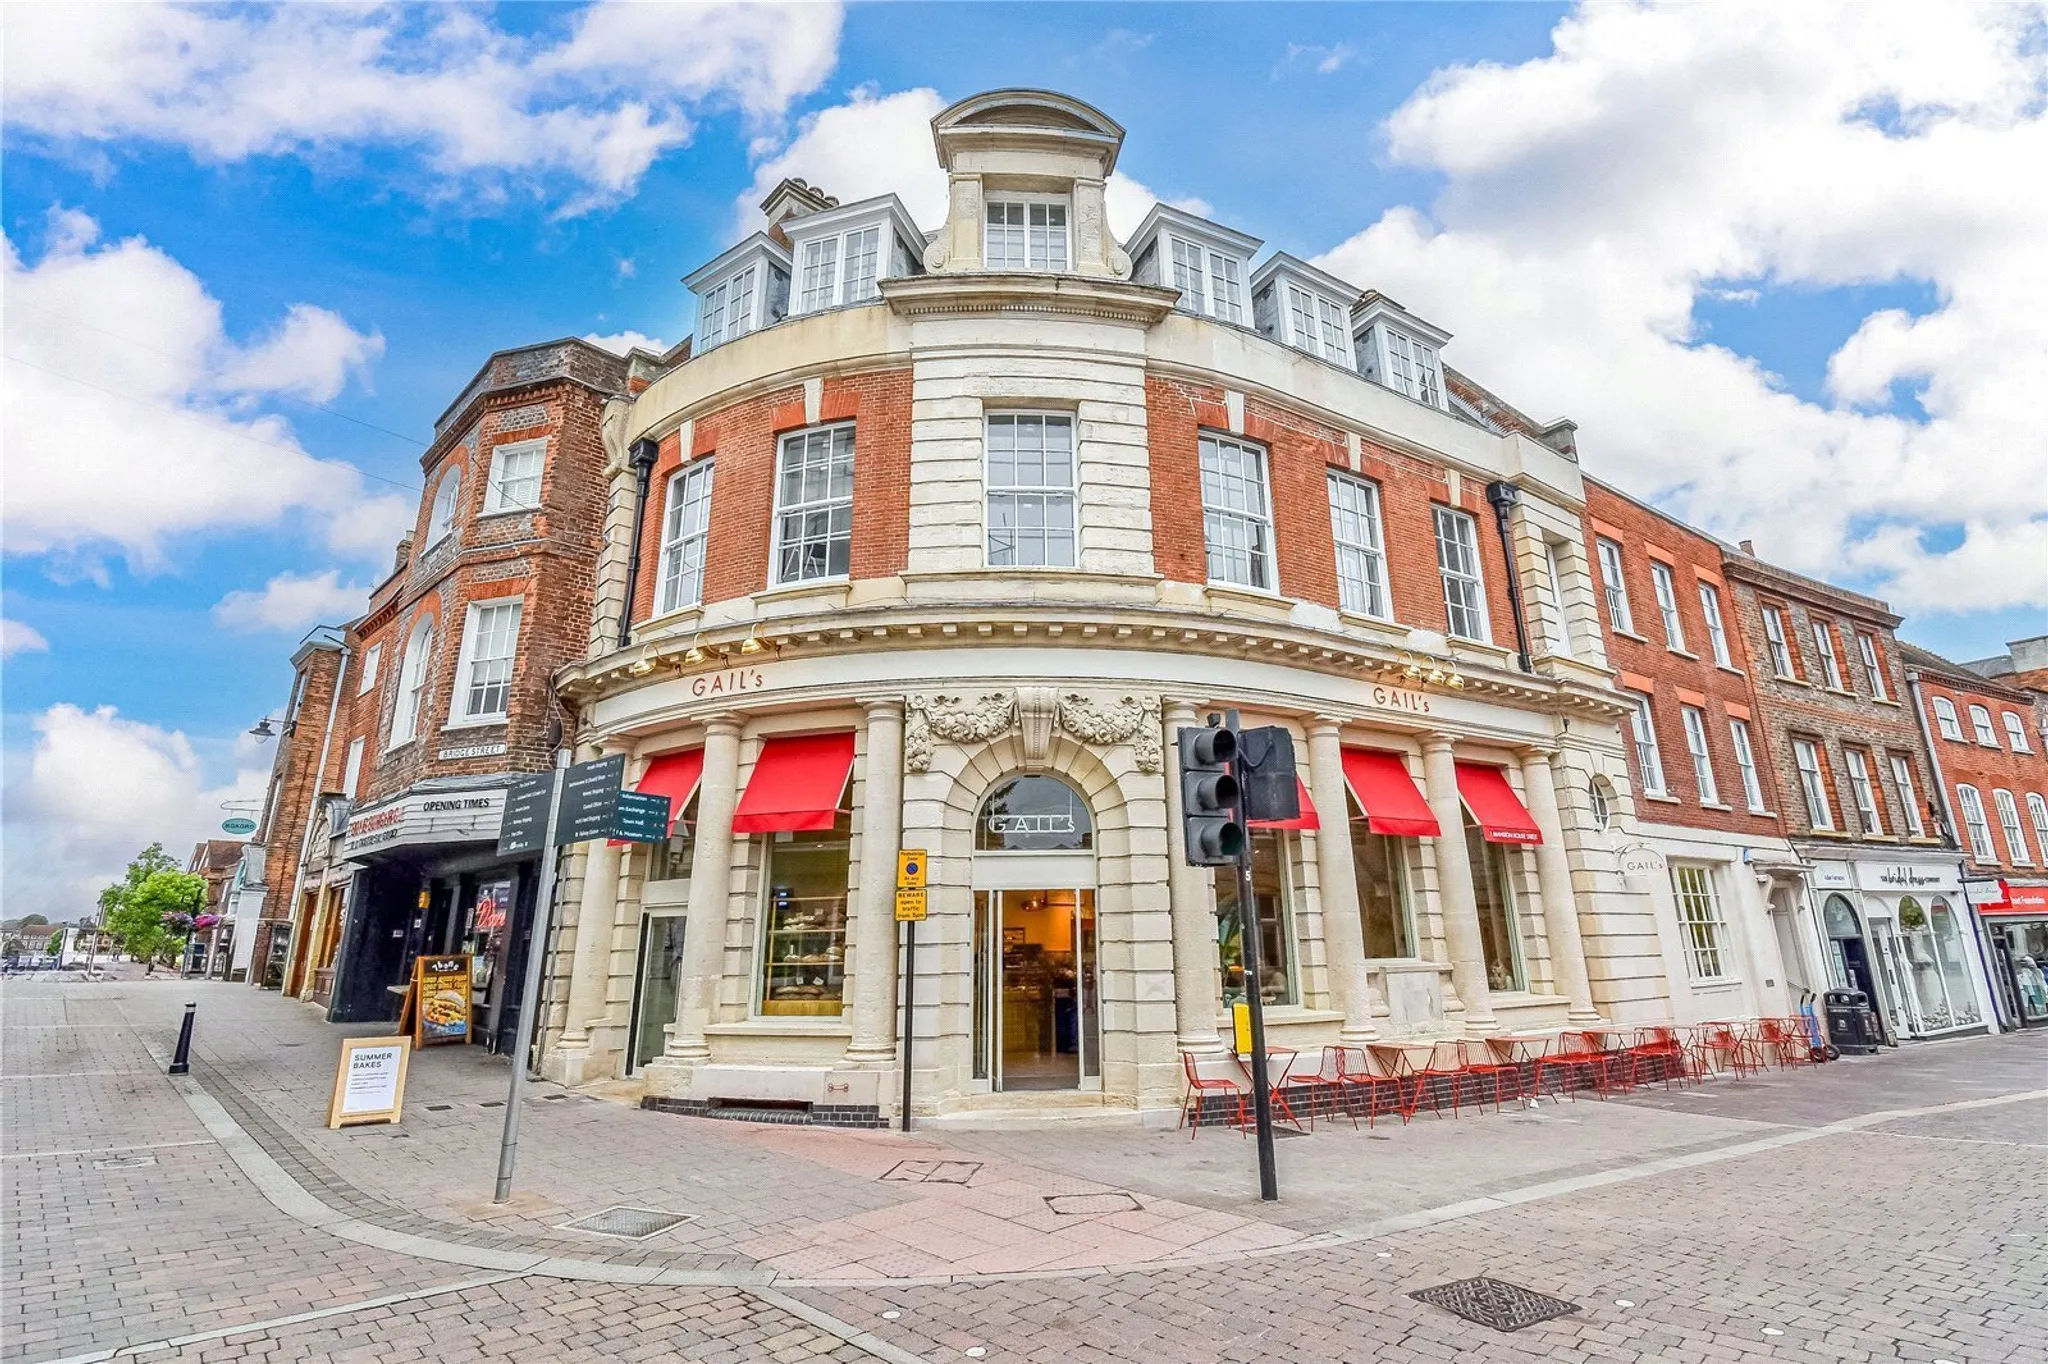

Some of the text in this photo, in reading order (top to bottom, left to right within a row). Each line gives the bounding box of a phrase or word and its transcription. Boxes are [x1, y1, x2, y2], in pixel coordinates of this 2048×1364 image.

[692, 669, 763, 697] GAIL's
[1373, 686, 1430, 712] GAIL's
[443, 745, 501, 758] BRIDGE STREET
[423, 798, 490, 812] OPENING TIMES
[1626, 861, 1663, 871] GAIL's
[1245, 871, 1252, 881] 5
[354, 1052, 393, 1061] SUMMER
[353, 1061, 382, 1069] BAKES
